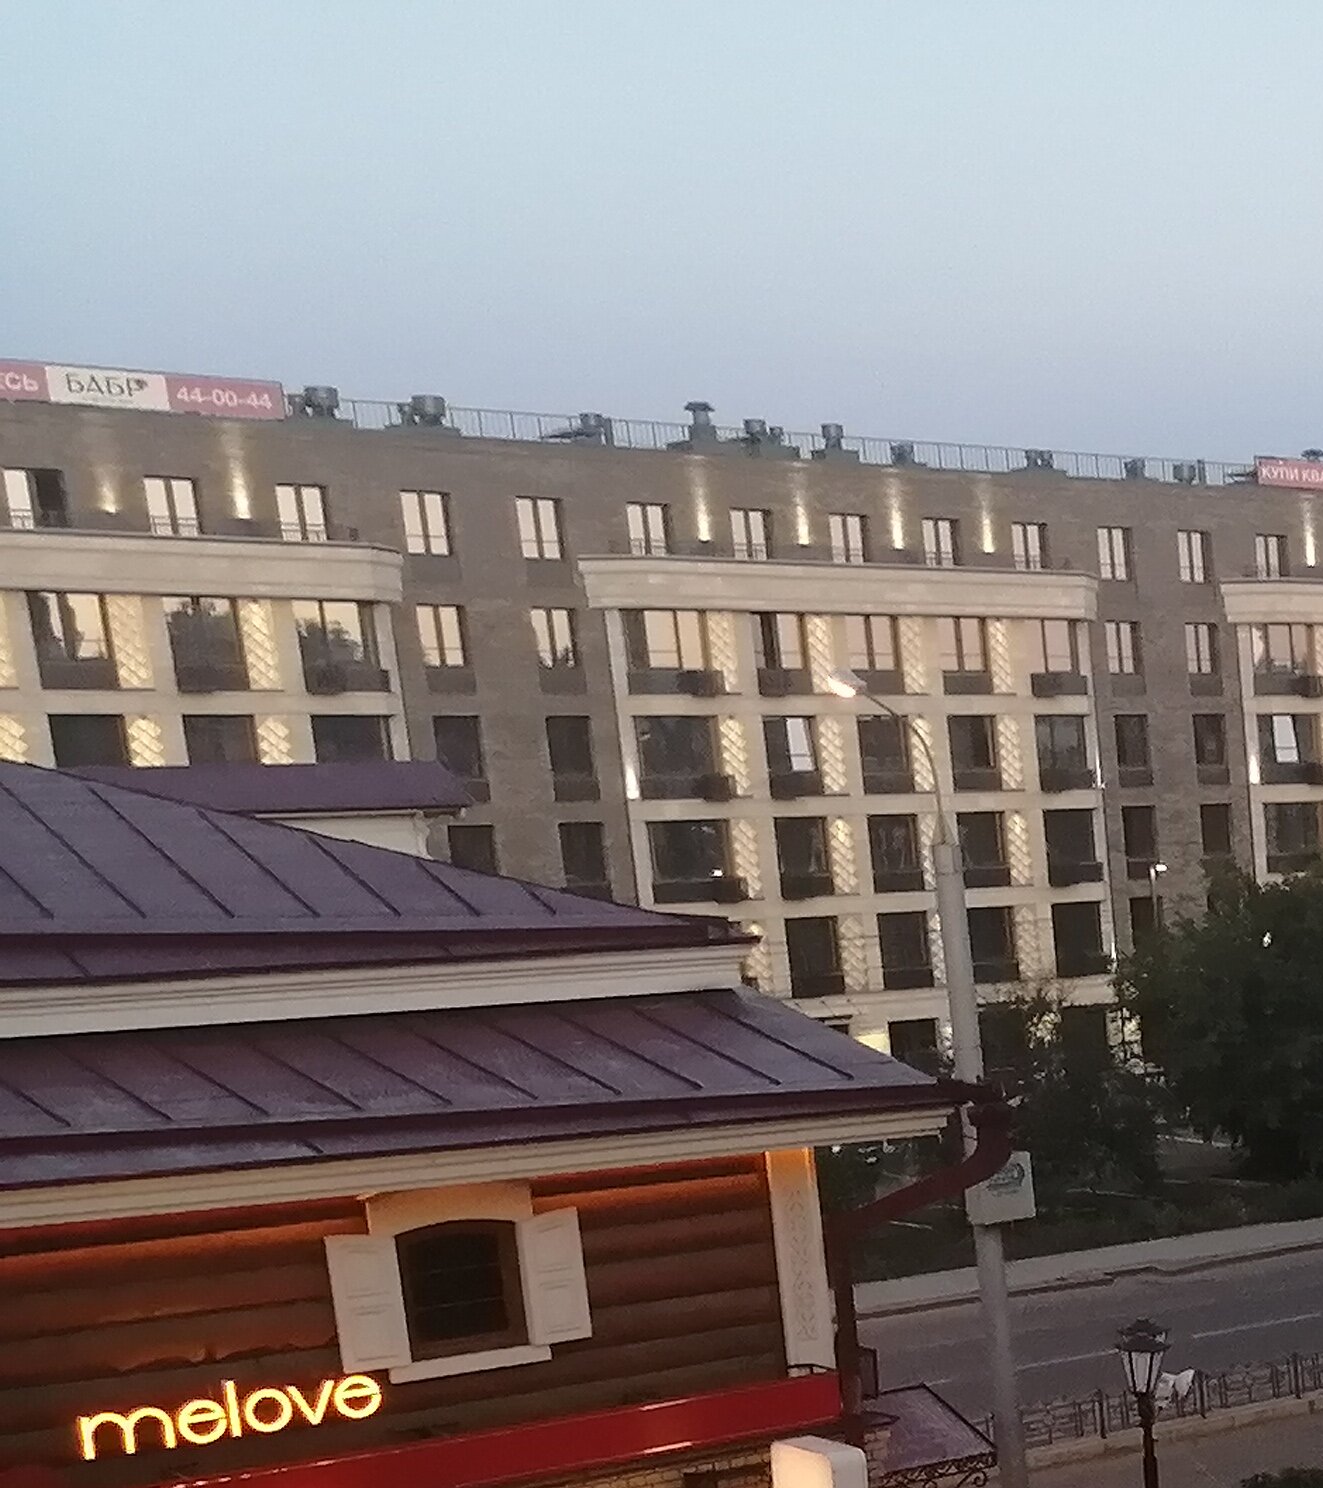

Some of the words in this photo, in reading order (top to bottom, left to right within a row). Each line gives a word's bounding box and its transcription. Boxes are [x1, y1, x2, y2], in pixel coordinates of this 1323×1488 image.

[0, 371, 38, 392] СЬ
[1261, 465, 1299, 481] КУПИ
[78, 1374, 383, 1461] melove
